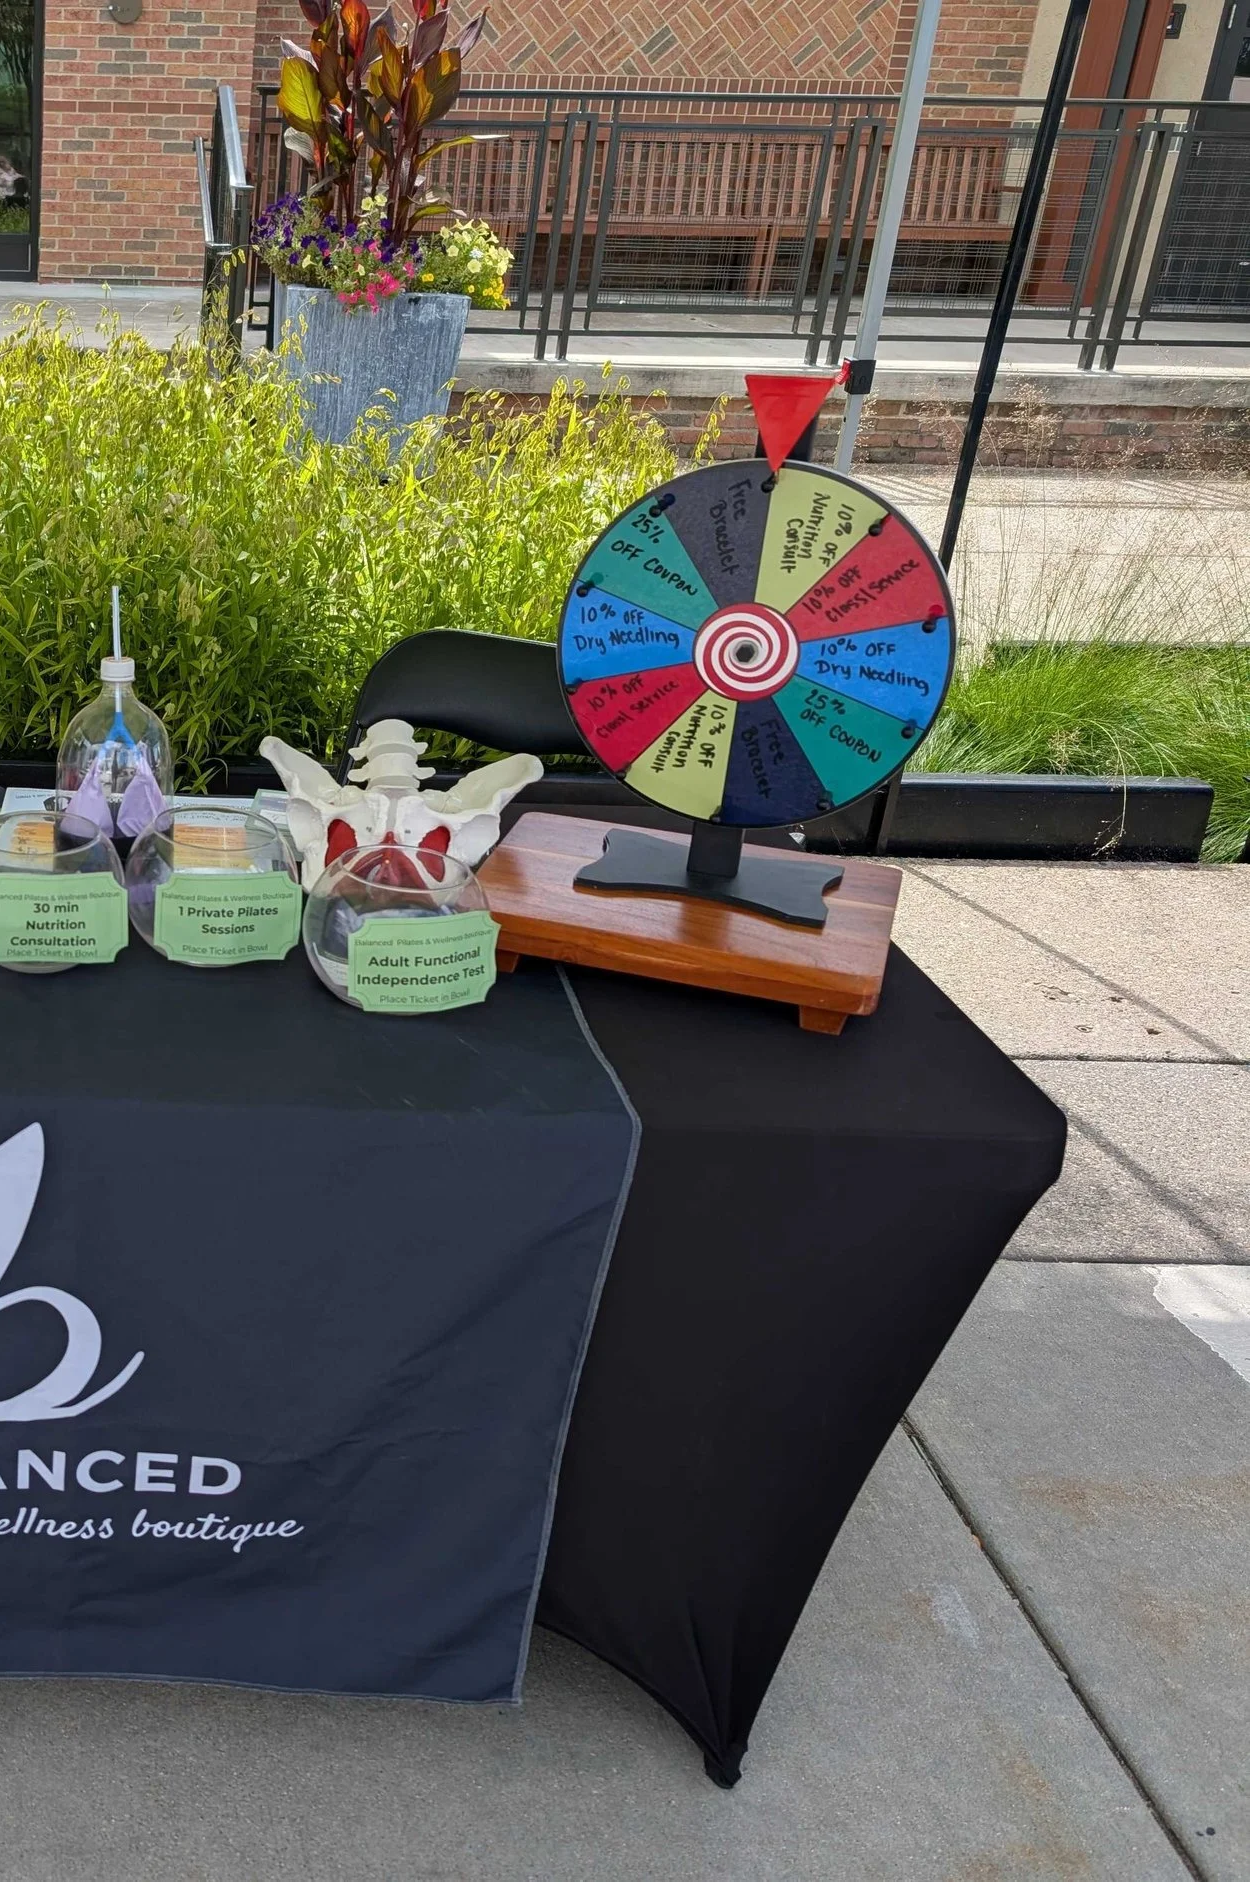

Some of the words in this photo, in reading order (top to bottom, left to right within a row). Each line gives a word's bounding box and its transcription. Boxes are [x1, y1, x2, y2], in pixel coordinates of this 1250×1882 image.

[728, 478, 752, 521] Free
[631, 513, 665, 544] 25%
[798, 492, 831, 560] Nutrition
[835, 503, 856, 537] 10%
[611, 540, 645, 561] OFF
[781, 518, 805, 574] Consult
[818, 542, 838, 568] OFF
[802, 585, 835, 615] 10%
[838, 565, 863, 589] OFF
[581, 603, 616, 624] 10%
[623, 609, 645, 625] OFF
[574, 635, 607, 655] Dry
[609, 628, 680, 650] Needling
[821, 638, 858, 657] 10%
[865, 642, 897, 657] OFF
[814, 660, 851, 680] Dry
[860, 665, 929, 697] Needling
[587, 684, 618, 712] 10%
[622, 675, 645, 695] OFF
[805, 689, 846, 716] 25%
[709, 704, 728, 736] 10%
[761, 719, 785, 766] Free
[800, 708, 827, 728] OFF
[829, 724, 883, 764] COUPON
[698, 743, 716, 769] OFF
[741, 725, 773, 799] Bracelet
[34, 903, 50, 914] 30
[54, 902, 79, 913] min
[179, 906, 184, 916] 1
[188, 907, 234, 918] Private
[238, 907, 279, 917] Pilates
[26, 920, 86, 930] Nutrition
[202, 924, 255, 935] Sessions
[7, 949, 30, 957] Place
[35, 949, 61, 957] Ticket
[11, 937, 96, 947] Consultation
[183, 945, 207, 954] Place
[210, 947, 237, 955] Ticket
[247, 944, 268, 953] Bowl
[368, 956, 410, 967] Adult
[415, 947, 481, 967] Functional
[357, 973, 460, 988] Independence
[463, 965, 485, 979] Test
[380, 995, 407, 1003] Place
[409, 995, 439, 1004] Ticket
[451, 989, 470, 1000] Bowl
[132, 1508, 305, 1553] boutique
